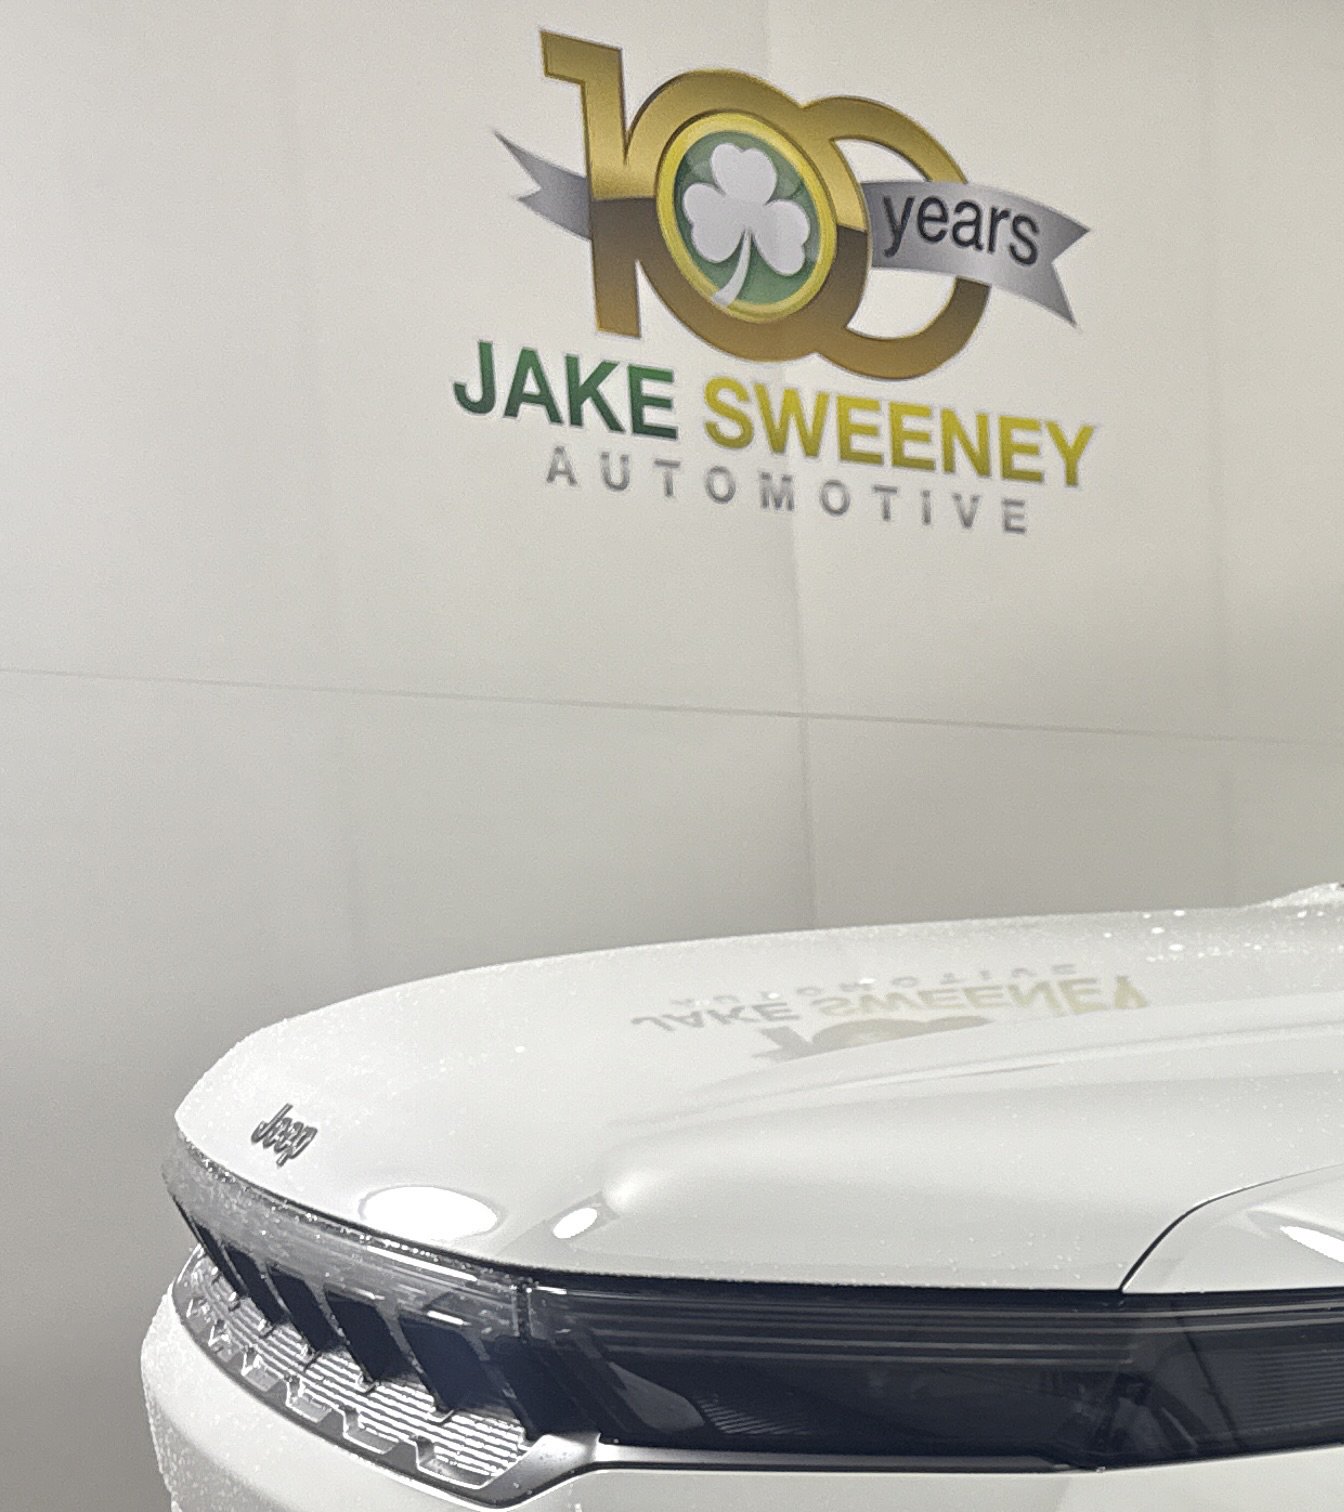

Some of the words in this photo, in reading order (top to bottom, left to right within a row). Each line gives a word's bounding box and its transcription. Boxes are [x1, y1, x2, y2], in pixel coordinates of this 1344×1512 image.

[881, 193, 1041, 266] years
[452, 339, 679, 441] JAKE
[703, 375, 1095, 488] SWEENEY
[545, 446, 1029, 535] AUTOMOTIVE
[251, 1103, 318, 1168] Jeep
